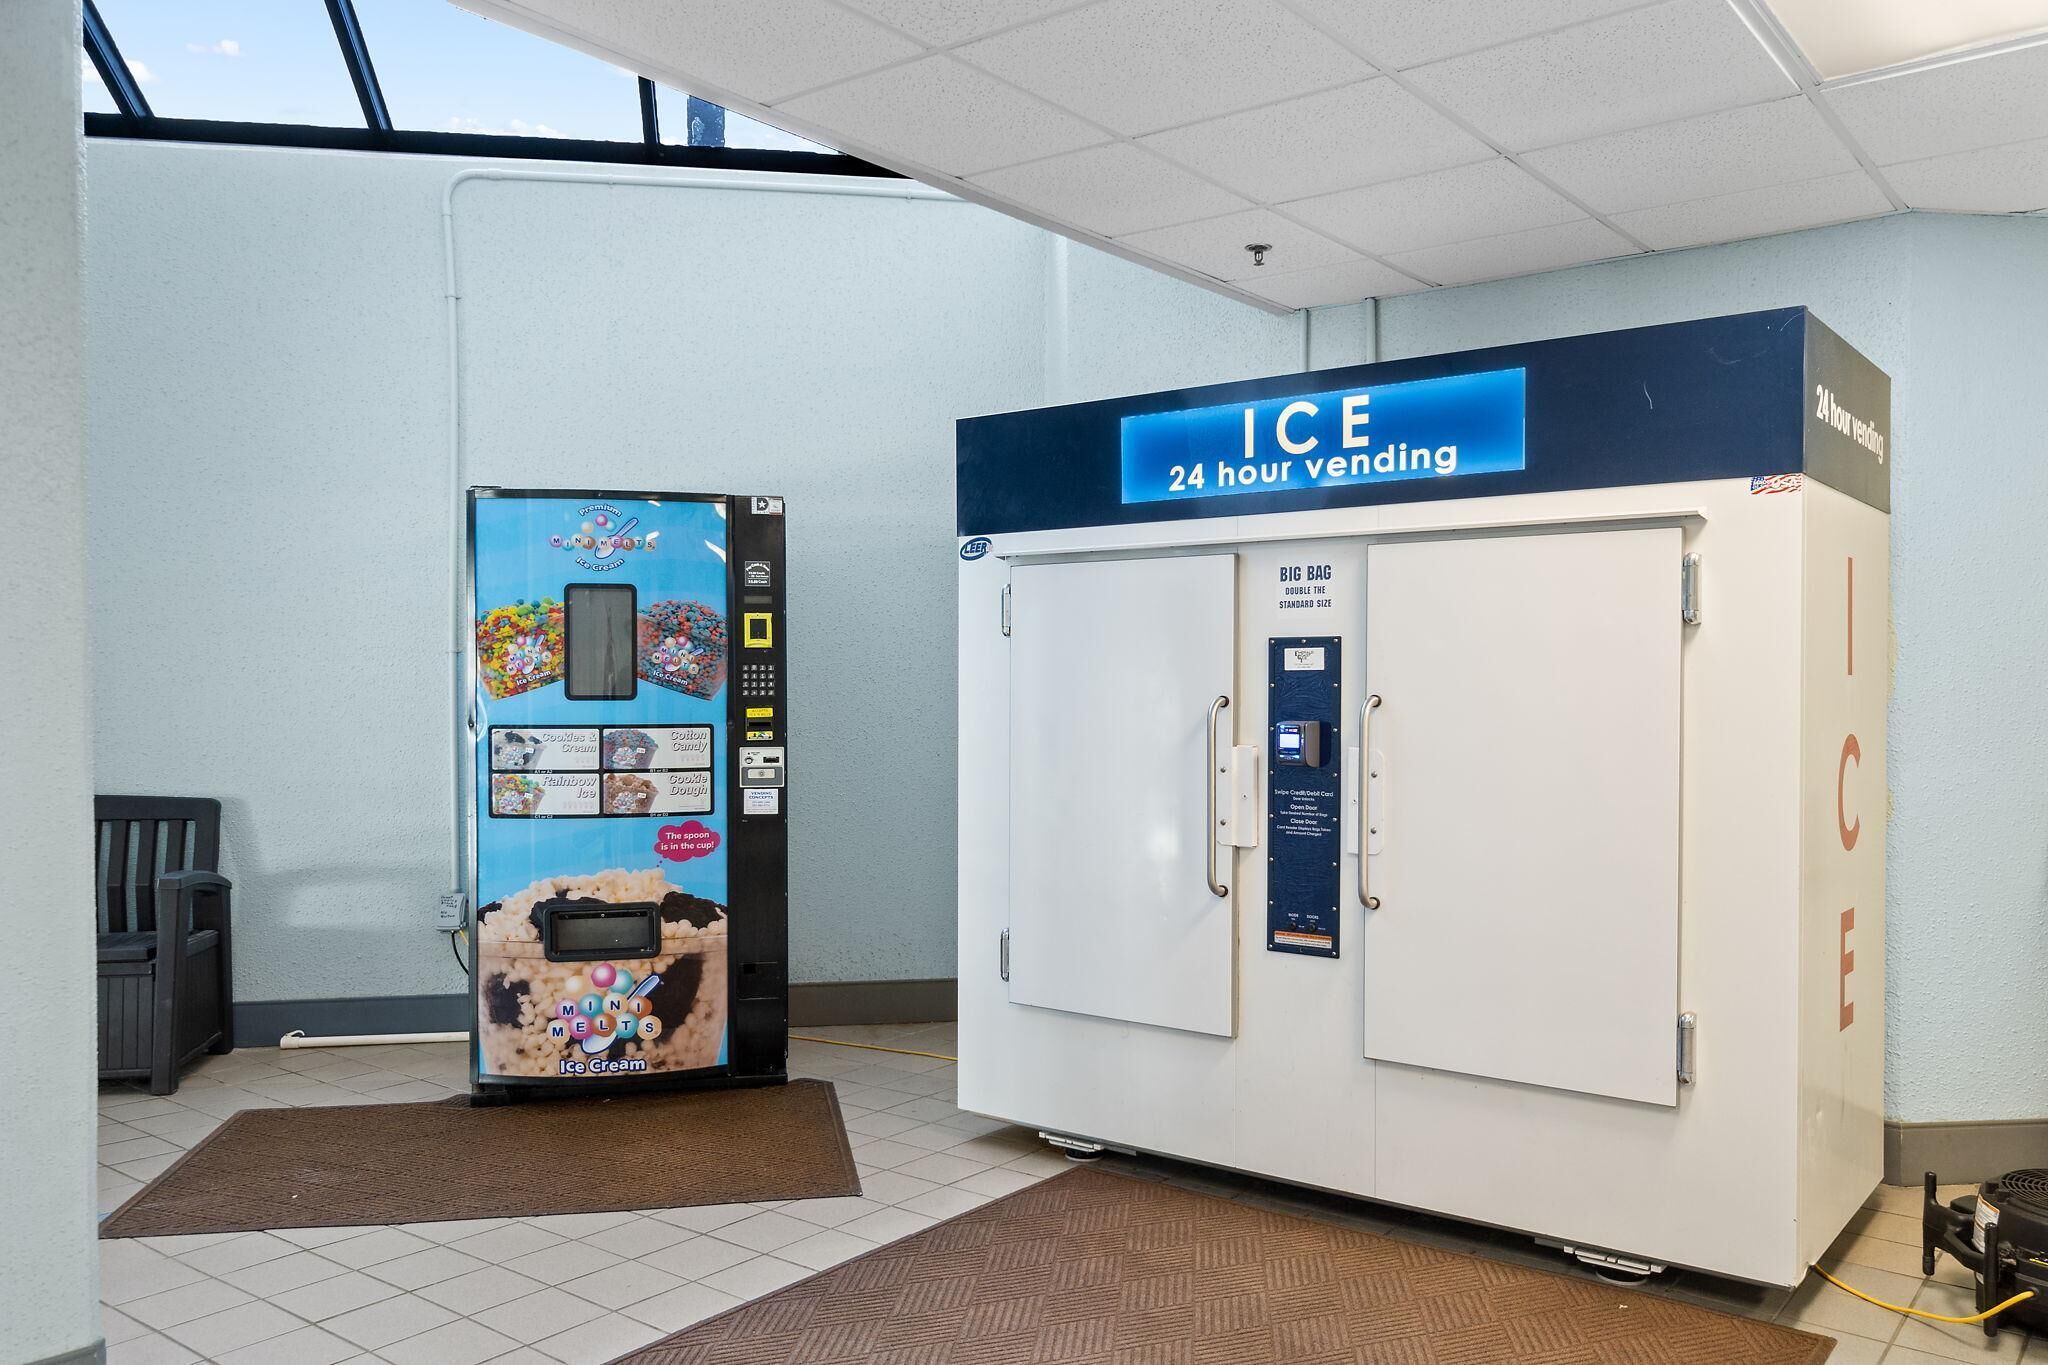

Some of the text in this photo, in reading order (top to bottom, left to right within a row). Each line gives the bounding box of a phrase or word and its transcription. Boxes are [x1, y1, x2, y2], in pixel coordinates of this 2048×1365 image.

[1244, 395, 1370, 458] ICE
[1816, 384, 1884, 464] 24 hour vending
[1168, 444, 1457, 492] 24 hour vending
[578, 504, 622, 516] Premium
[551, 536, 592, 549] MINI
[964, 542, 988, 554] LEER
[576, 558, 624, 571] Ice Cream
[1280, 564, 1332, 582] BIG BAG
[1285, 586, 1326, 595] DOUBLE THE
[1280, 599, 1332, 608] STANDARD SIZE
[528, 670, 552, 681] Cream
[665, 674, 688, 685] Cream
[542, 733, 585, 742] Cookies
[672, 730, 707, 740] Cotton
[562, 744, 597, 752] Cream
[672, 741, 708, 753] Candy
[542, 776, 597, 786] Rainbow
[670, 774, 707, 784] Cookie
[577, 788, 596, 798] Ice
[670, 785, 707, 797] Dough
[697, 841, 715, 850] cup!
[560, 997, 645, 1018] MINI
[551, 1017, 657, 1040] MELTS
[560, 1058, 646, 1074] Ice Cream
